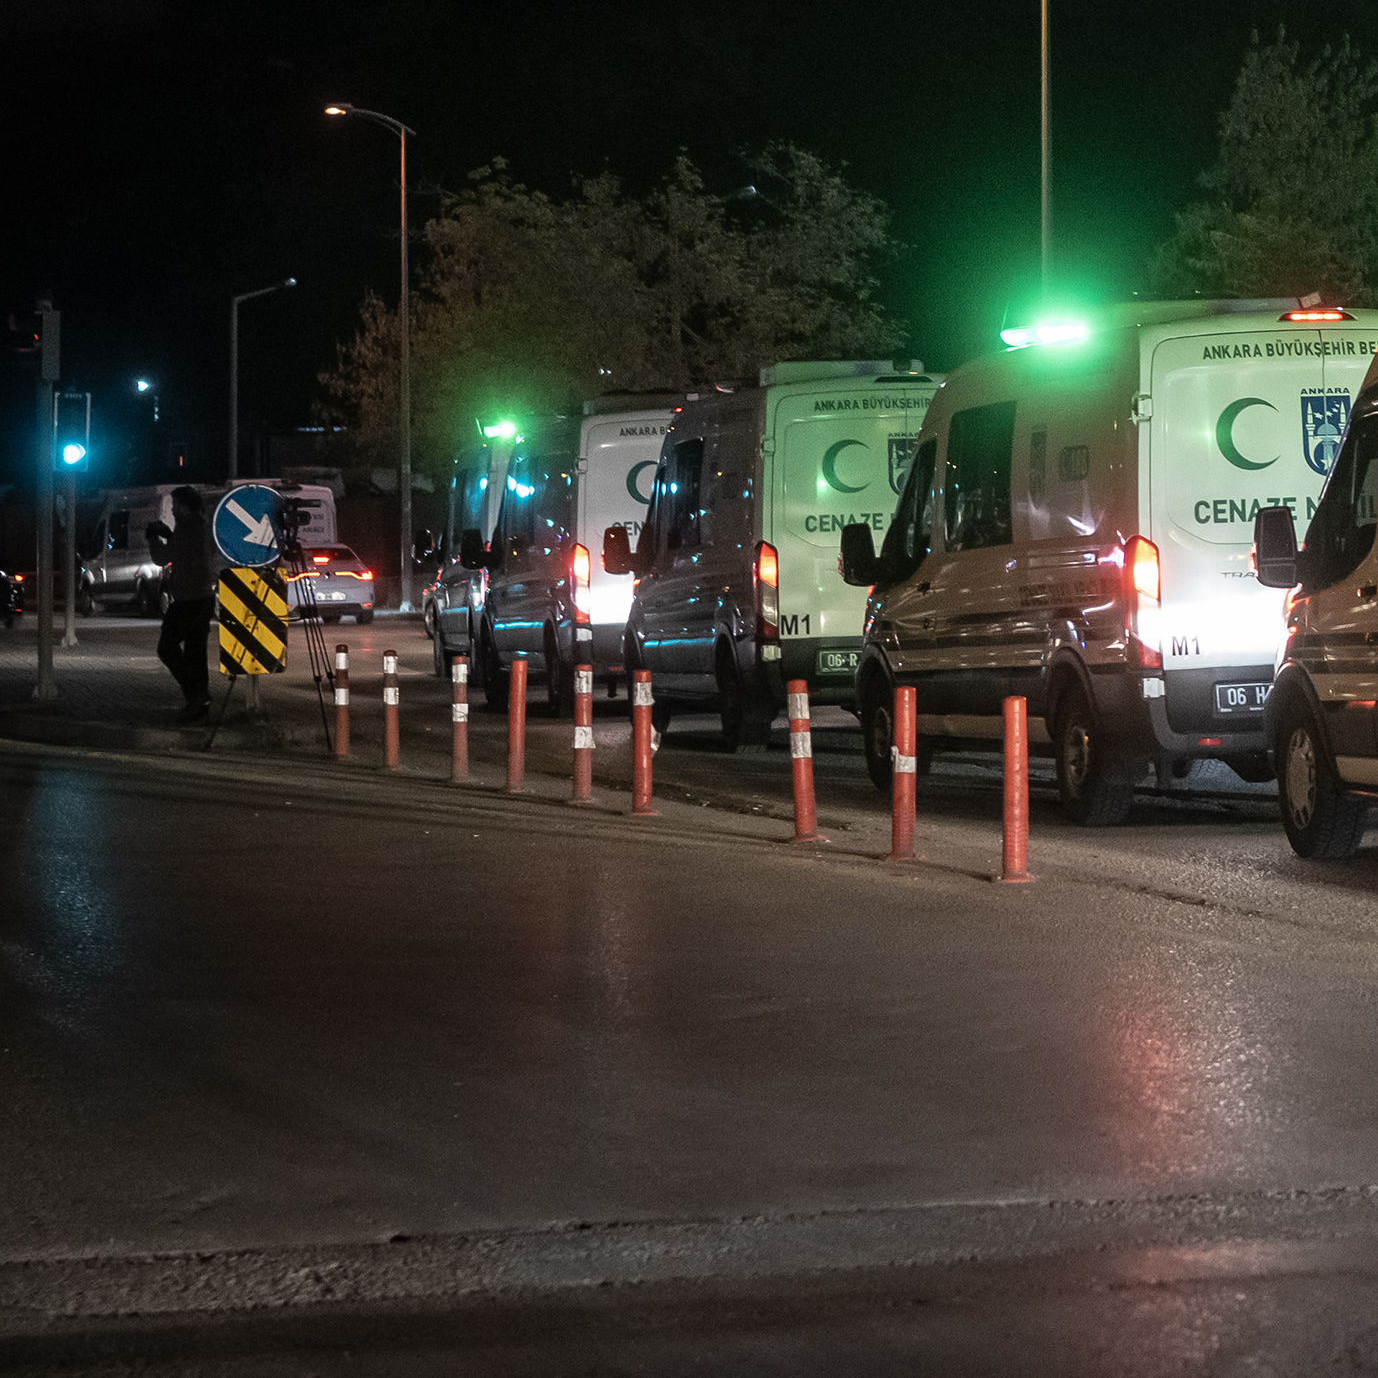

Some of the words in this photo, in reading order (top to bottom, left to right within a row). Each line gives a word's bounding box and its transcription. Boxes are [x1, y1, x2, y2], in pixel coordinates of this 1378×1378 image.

[1203, 344, 1263, 360] ANKARA
[1266, 339, 1356, 359] BÜYÜKŞEHİR
[1300, 387, 1350, 395] ANKARA
[814, 400, 860, 412] ANKARA
[780, 614, 811, 635] M1
[1171, 635, 1201, 656] M1
[827, 653, 842, 667] 06
[1227, 687, 1247, 706] 06
